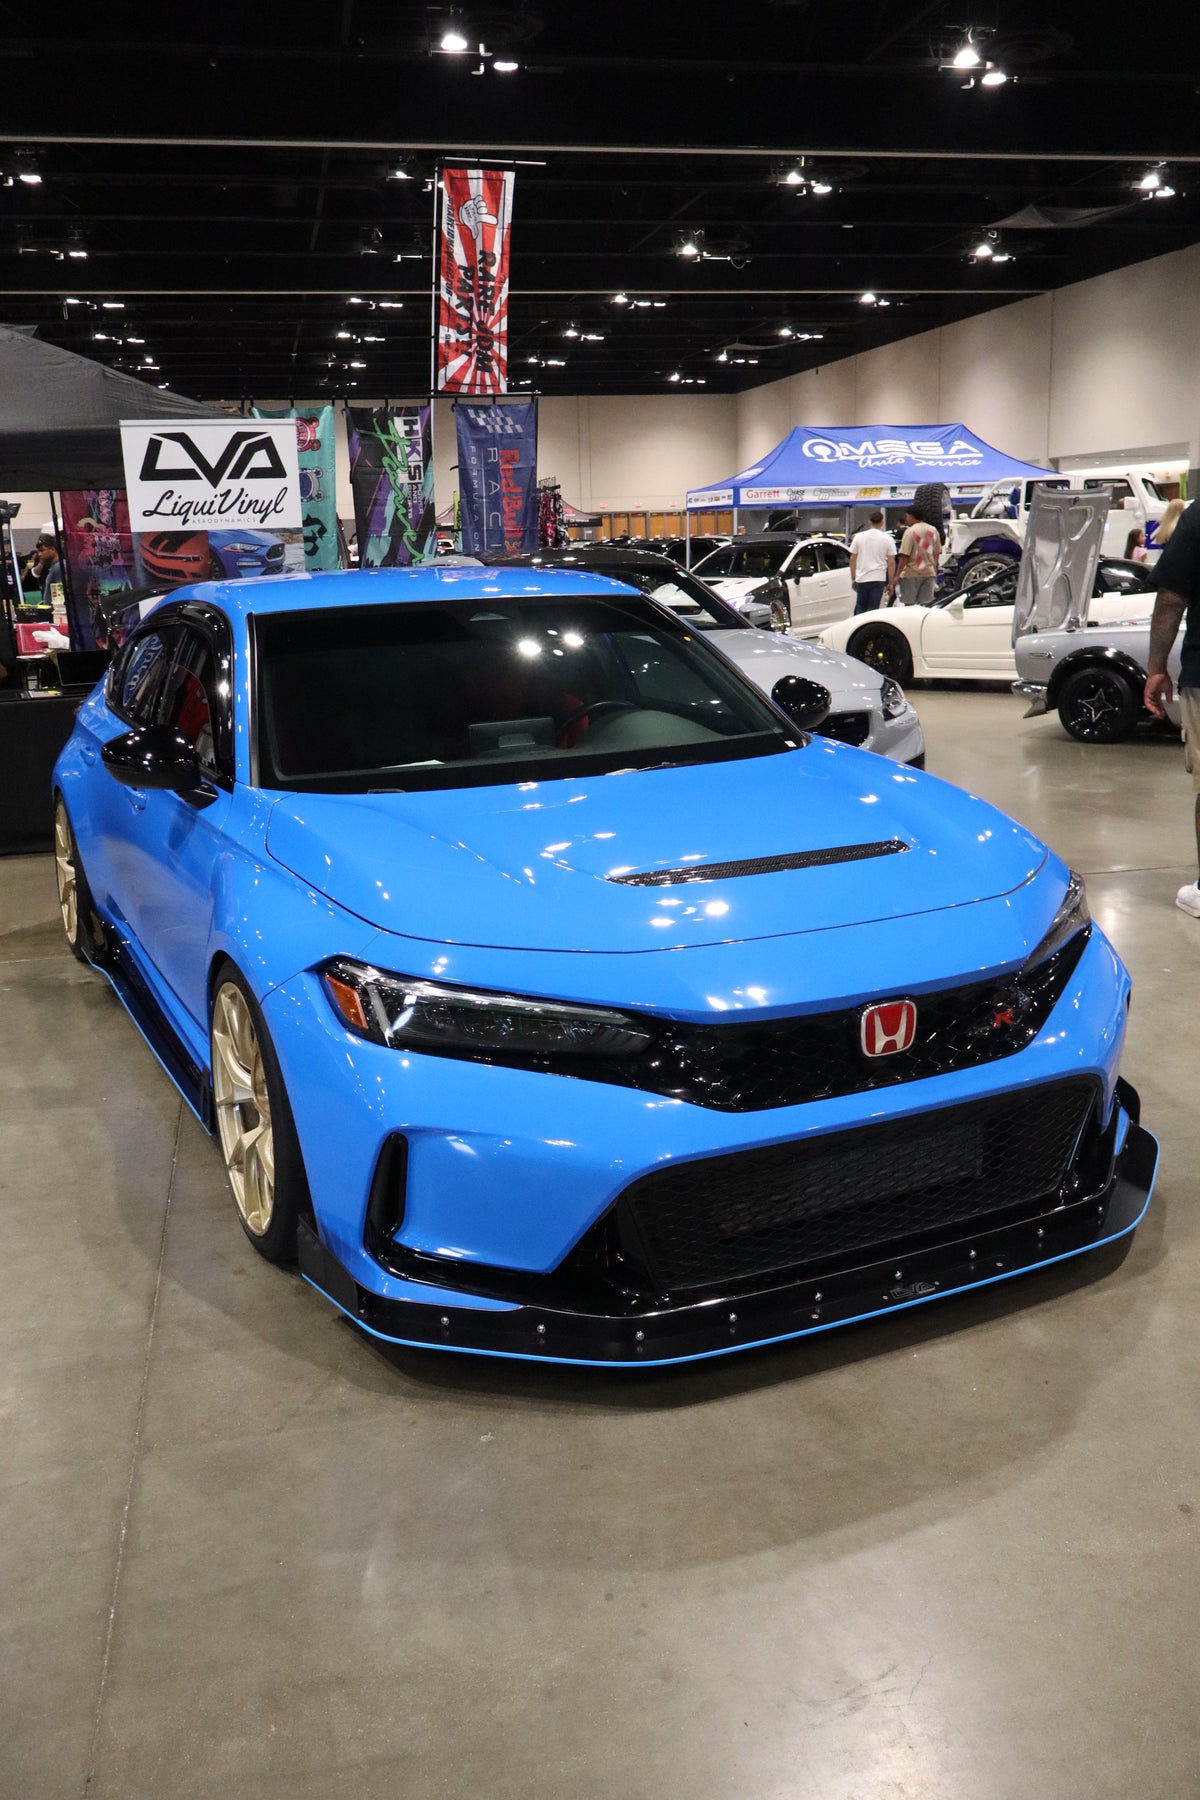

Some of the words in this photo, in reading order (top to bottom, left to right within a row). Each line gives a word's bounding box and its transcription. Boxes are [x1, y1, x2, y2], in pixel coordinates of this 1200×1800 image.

[477, 249, 497, 316] RARE
[475, 320, 495, 374] JDM
[139, 431, 287, 489] LVA
[403, 418, 423, 481] HKS
[499, 449, 523, 493] Red
[802, 438, 984, 462] OMEGA
[858, 456, 905, 468] Auto
[914, 457, 982, 467] Service
[142, 486, 288, 526] LiquiVinyl
[487, 447, 502, 547] RACI
[746, 488, 780, 499] Garrett
[502, 496, 524, 539] Bull
